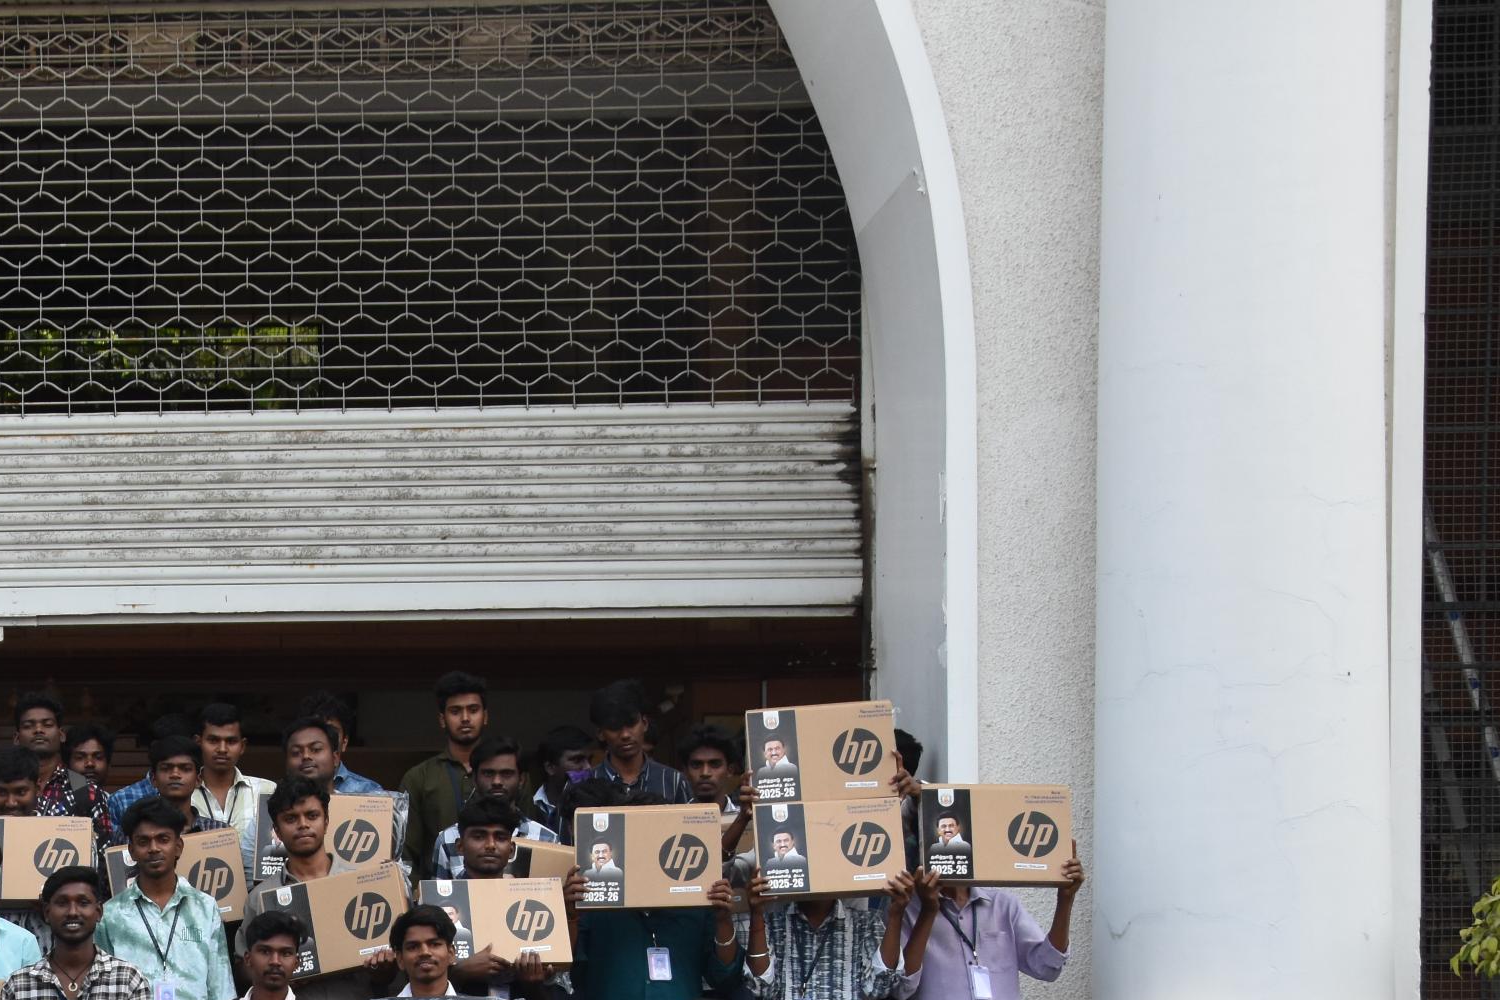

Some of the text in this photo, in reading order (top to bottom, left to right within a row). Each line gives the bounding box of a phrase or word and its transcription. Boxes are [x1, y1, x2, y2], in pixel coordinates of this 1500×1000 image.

[839, 728, 877, 775] hp
[760, 787, 795, 799] 2025-26
[39, 838, 75, 873] hp
[338, 819, 375, 863] hp
[847, 822, 885, 867] hp
[1014, 811, 1054, 858] hp
[196, 858, 228, 899] hp
[664, 834, 703, 881] hp
[352, 893, 386, 940] hp
[584, 892, 618, 901] 2025-26
[513, 900, 550, 941] hp
